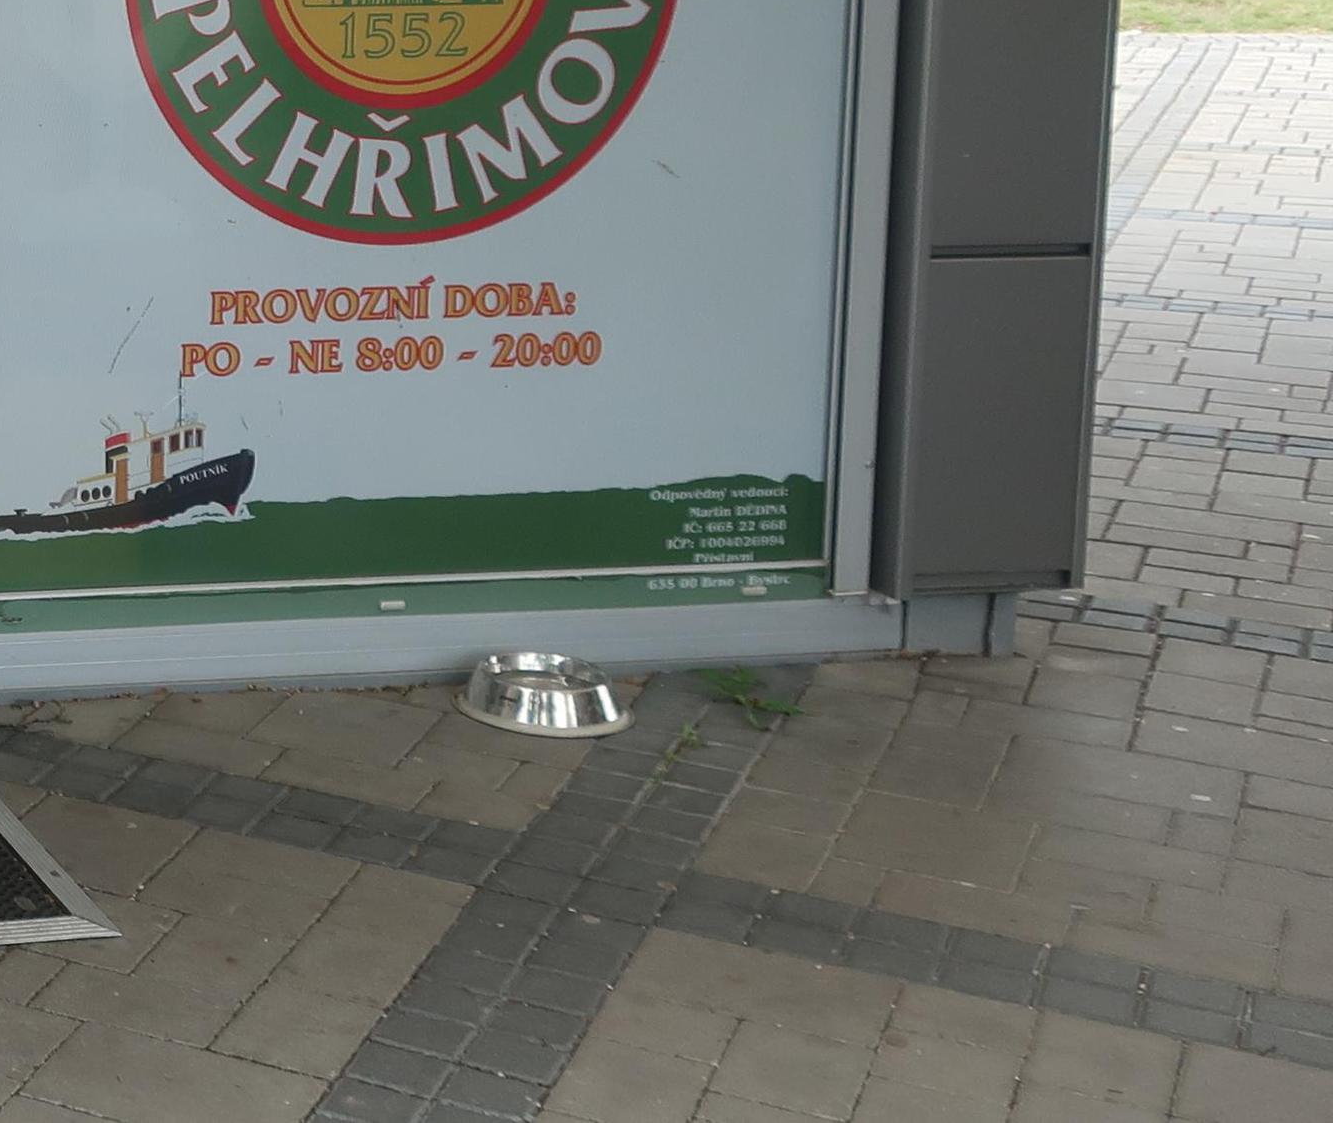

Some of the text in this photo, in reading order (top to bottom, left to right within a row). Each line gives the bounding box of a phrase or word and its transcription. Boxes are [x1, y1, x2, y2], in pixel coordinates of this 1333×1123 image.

[339, 12, 469, 60] 1552
[210, 276, 577, 325] PROVOZNÍ DOBA:
[180, 342, 241, 377] PO
[289, 338, 343, 373] NE
[355, 335, 444, 372] 8:00
[490, 330, 602, 369] 20:00
[179, 463, 230, 485] POUTNÍK
[650, 488, 727, 503] Odpovědný
[688, 506, 732, 518] Martin
[739, 520, 756, 532] 22
[647, 579, 675, 591] 635
[701, 576, 735, 588] Brno
